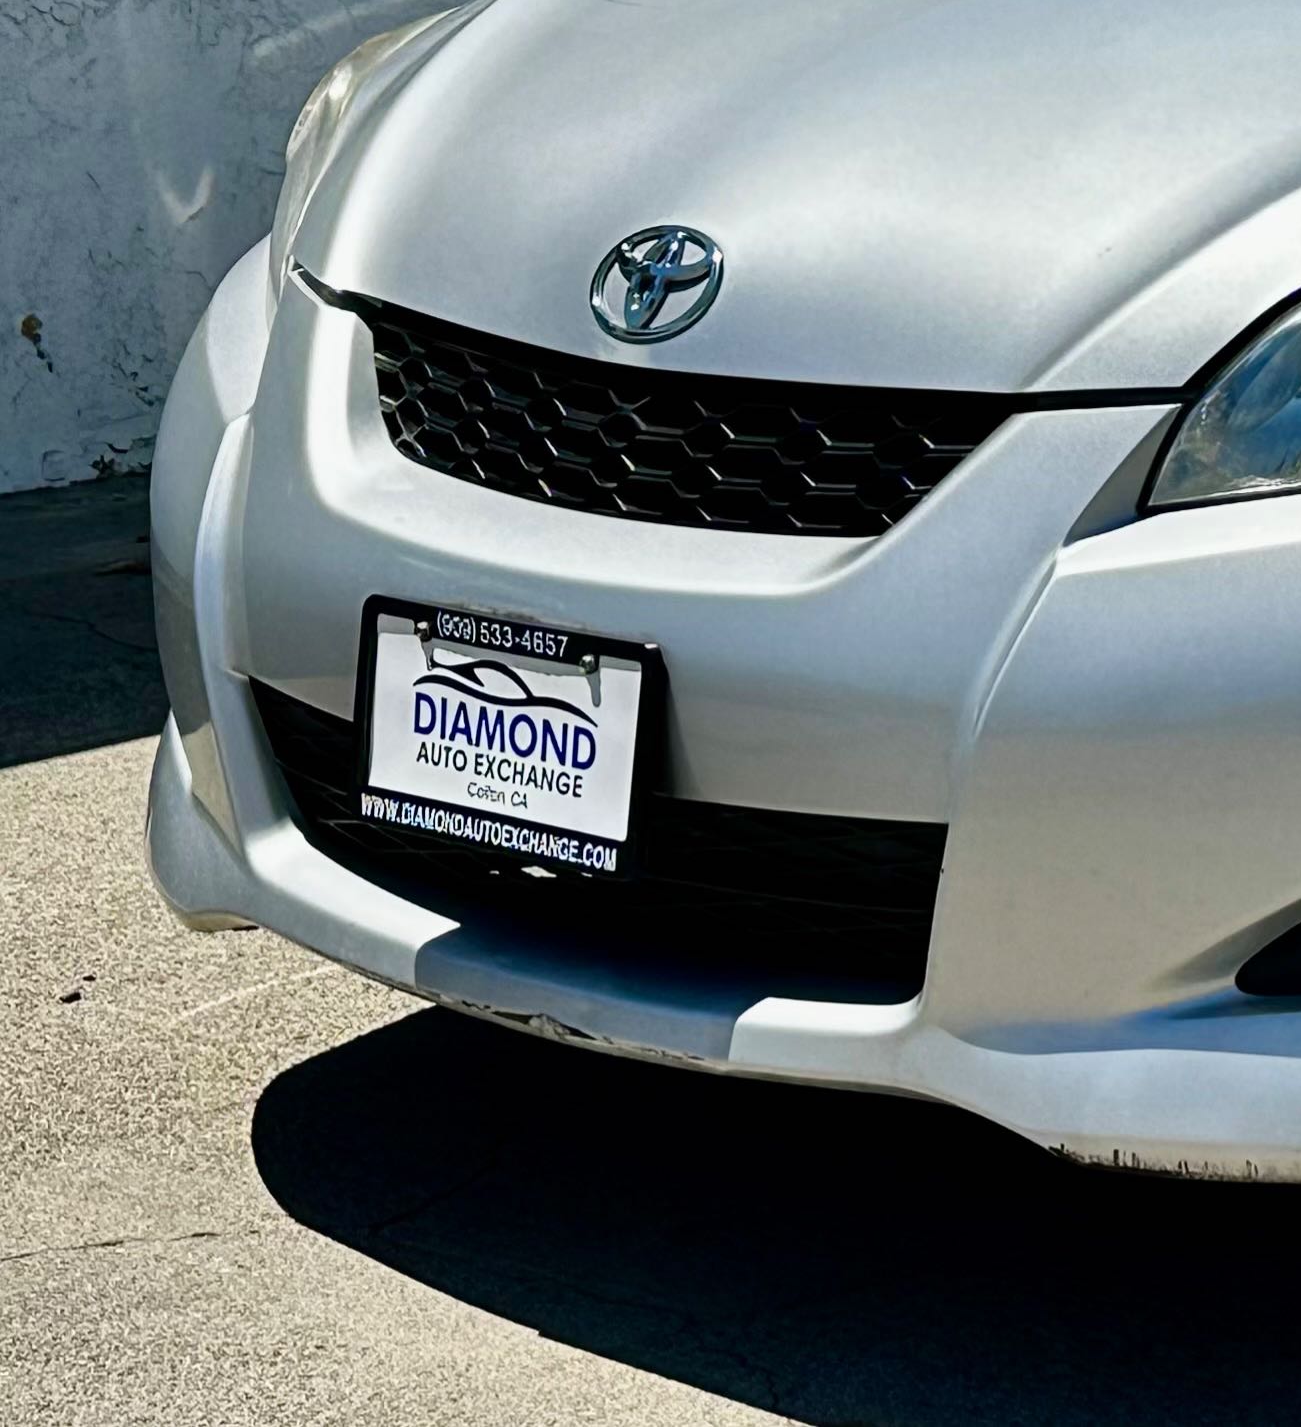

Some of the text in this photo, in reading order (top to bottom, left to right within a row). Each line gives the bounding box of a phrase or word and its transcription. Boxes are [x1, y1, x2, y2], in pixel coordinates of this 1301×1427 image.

[480, 622, 569, 658] 533-4657
[413, 691, 597, 771] DIAMOND
[416, 741, 584, 799] AUTO EXCHANGE
[360, 792, 618, 872] WWW.DIAMONDAUTOEXCHANGE.COM
